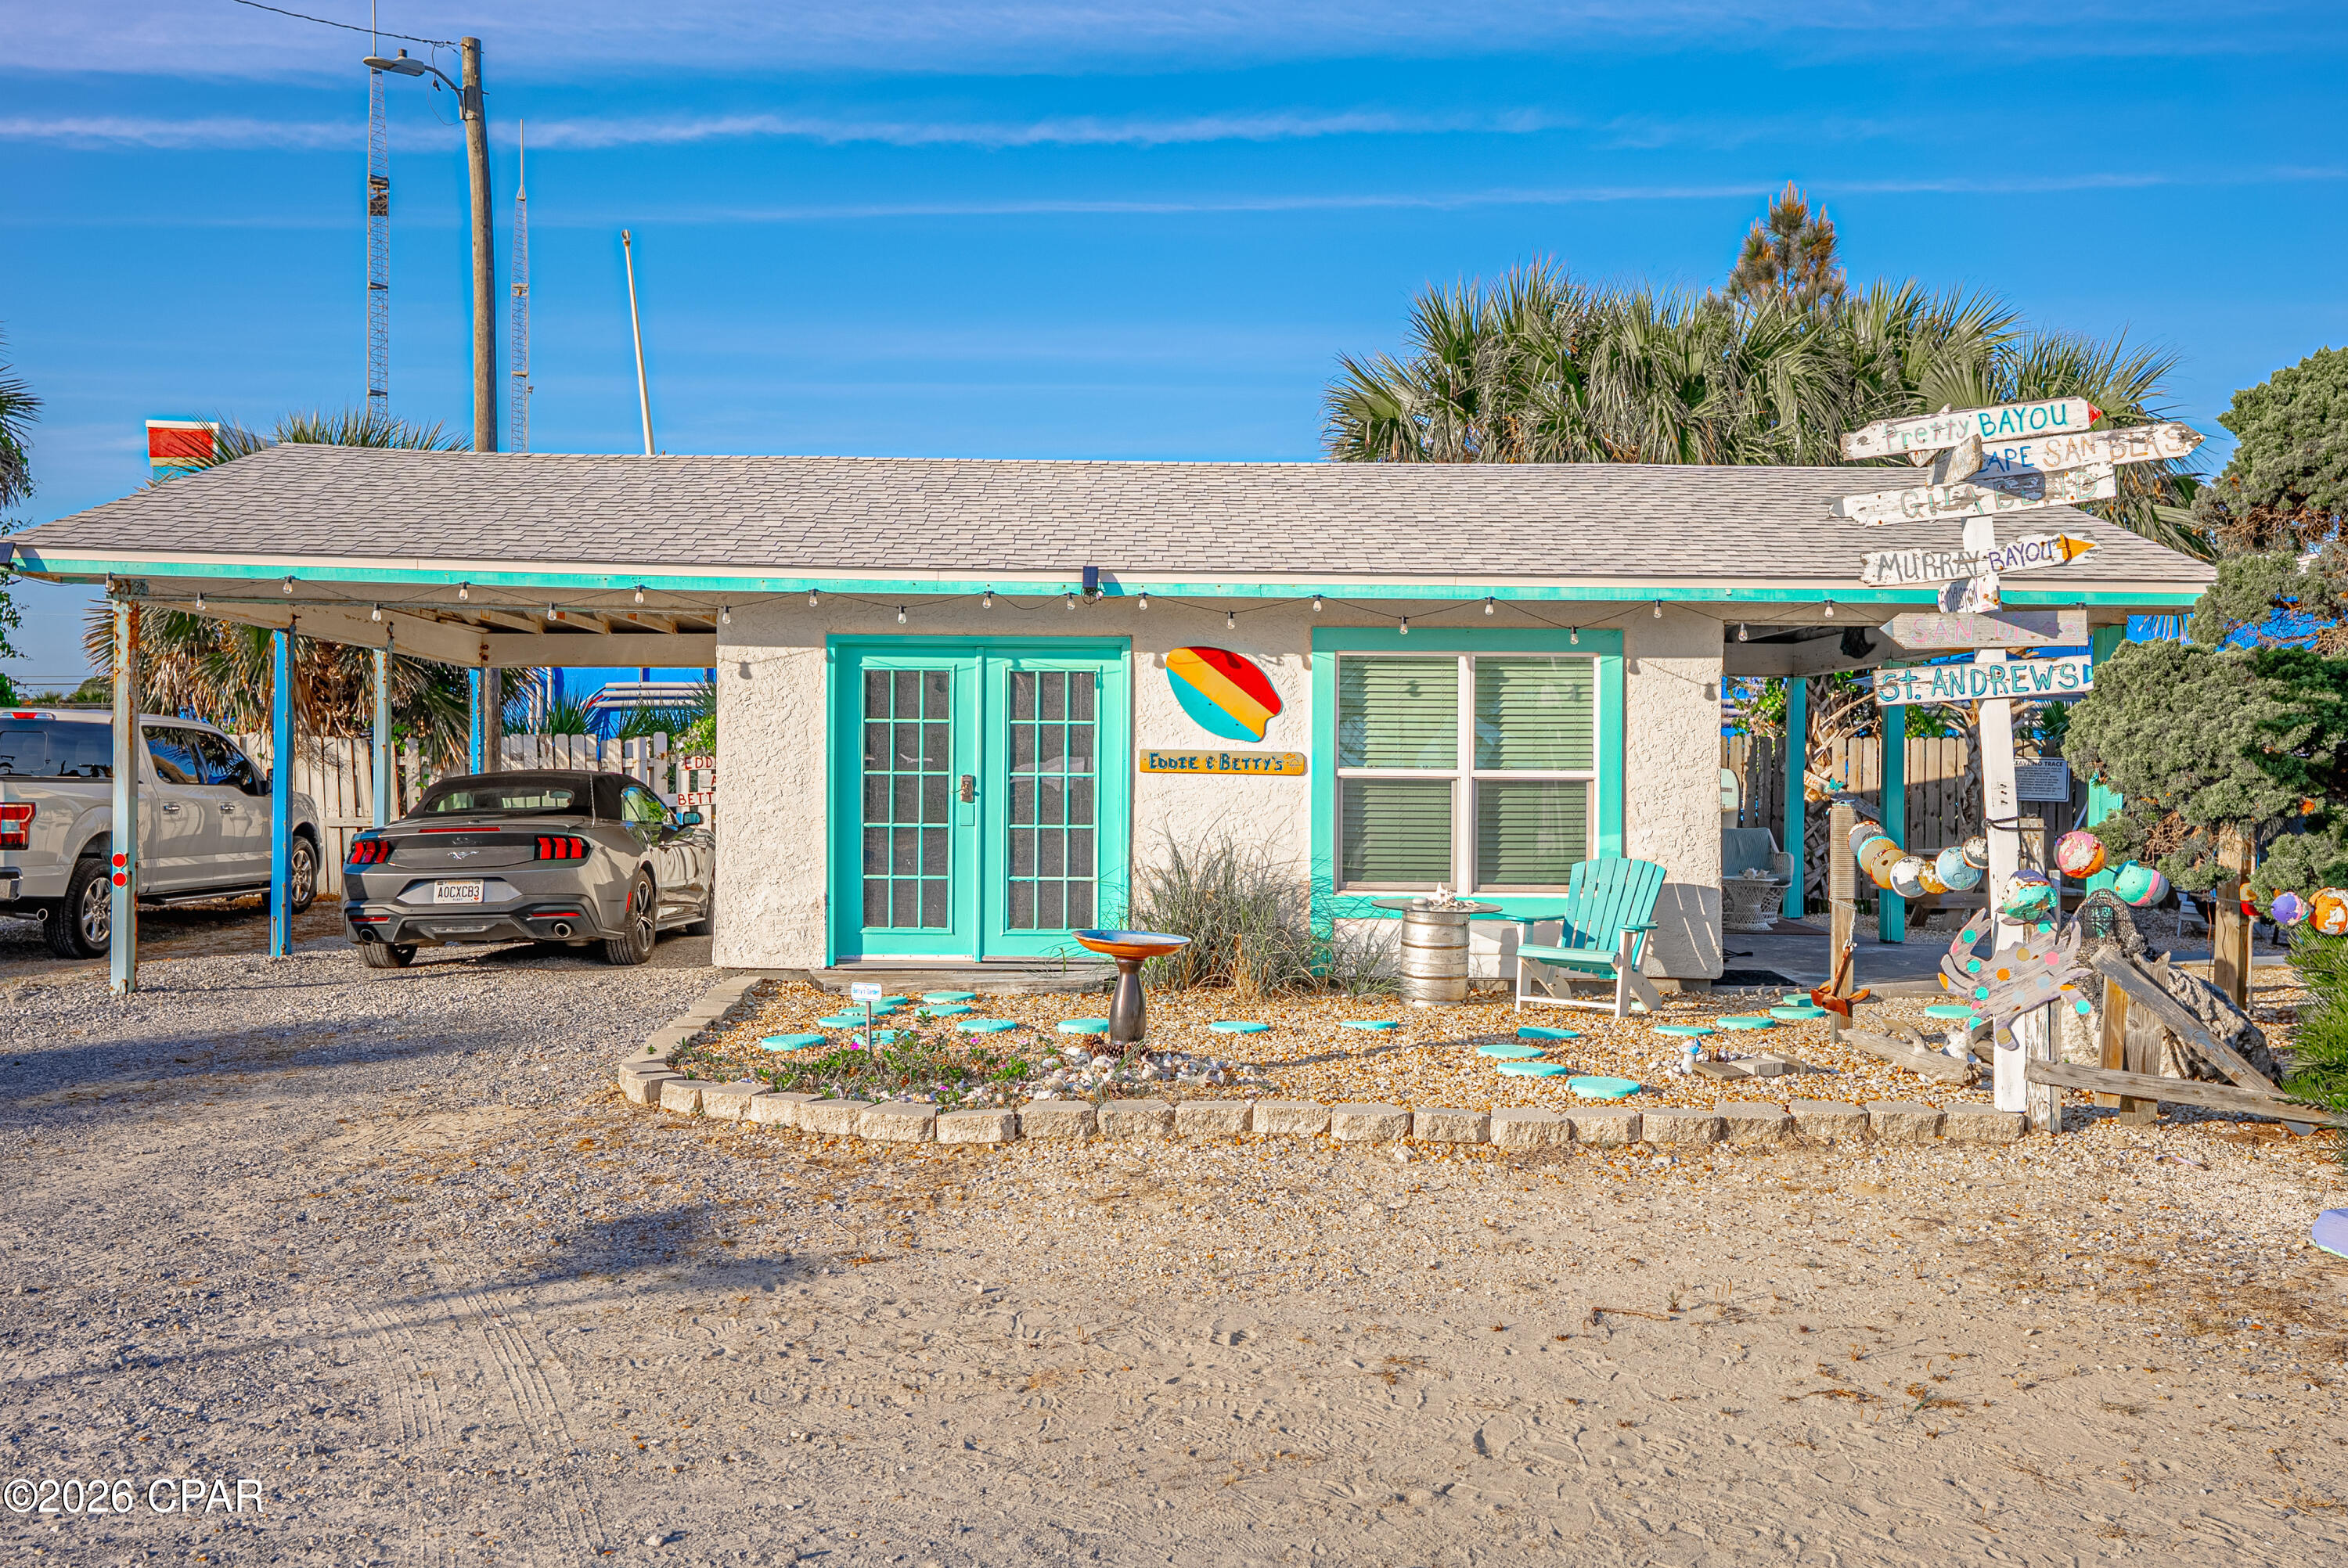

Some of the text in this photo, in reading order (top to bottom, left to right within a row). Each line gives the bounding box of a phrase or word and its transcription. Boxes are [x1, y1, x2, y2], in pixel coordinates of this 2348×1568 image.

[1884, 403, 2069, 451] Pretty BAYOU
[2042, 432, 2096, 468] SAN
[1877, 540, 2055, 582] MURRAY BAYOU
[1910, 617, 1974, 644] SAN
[1931, 662, 2080, 698] ANDREWS
[1205, 756, 1215, 770] &
